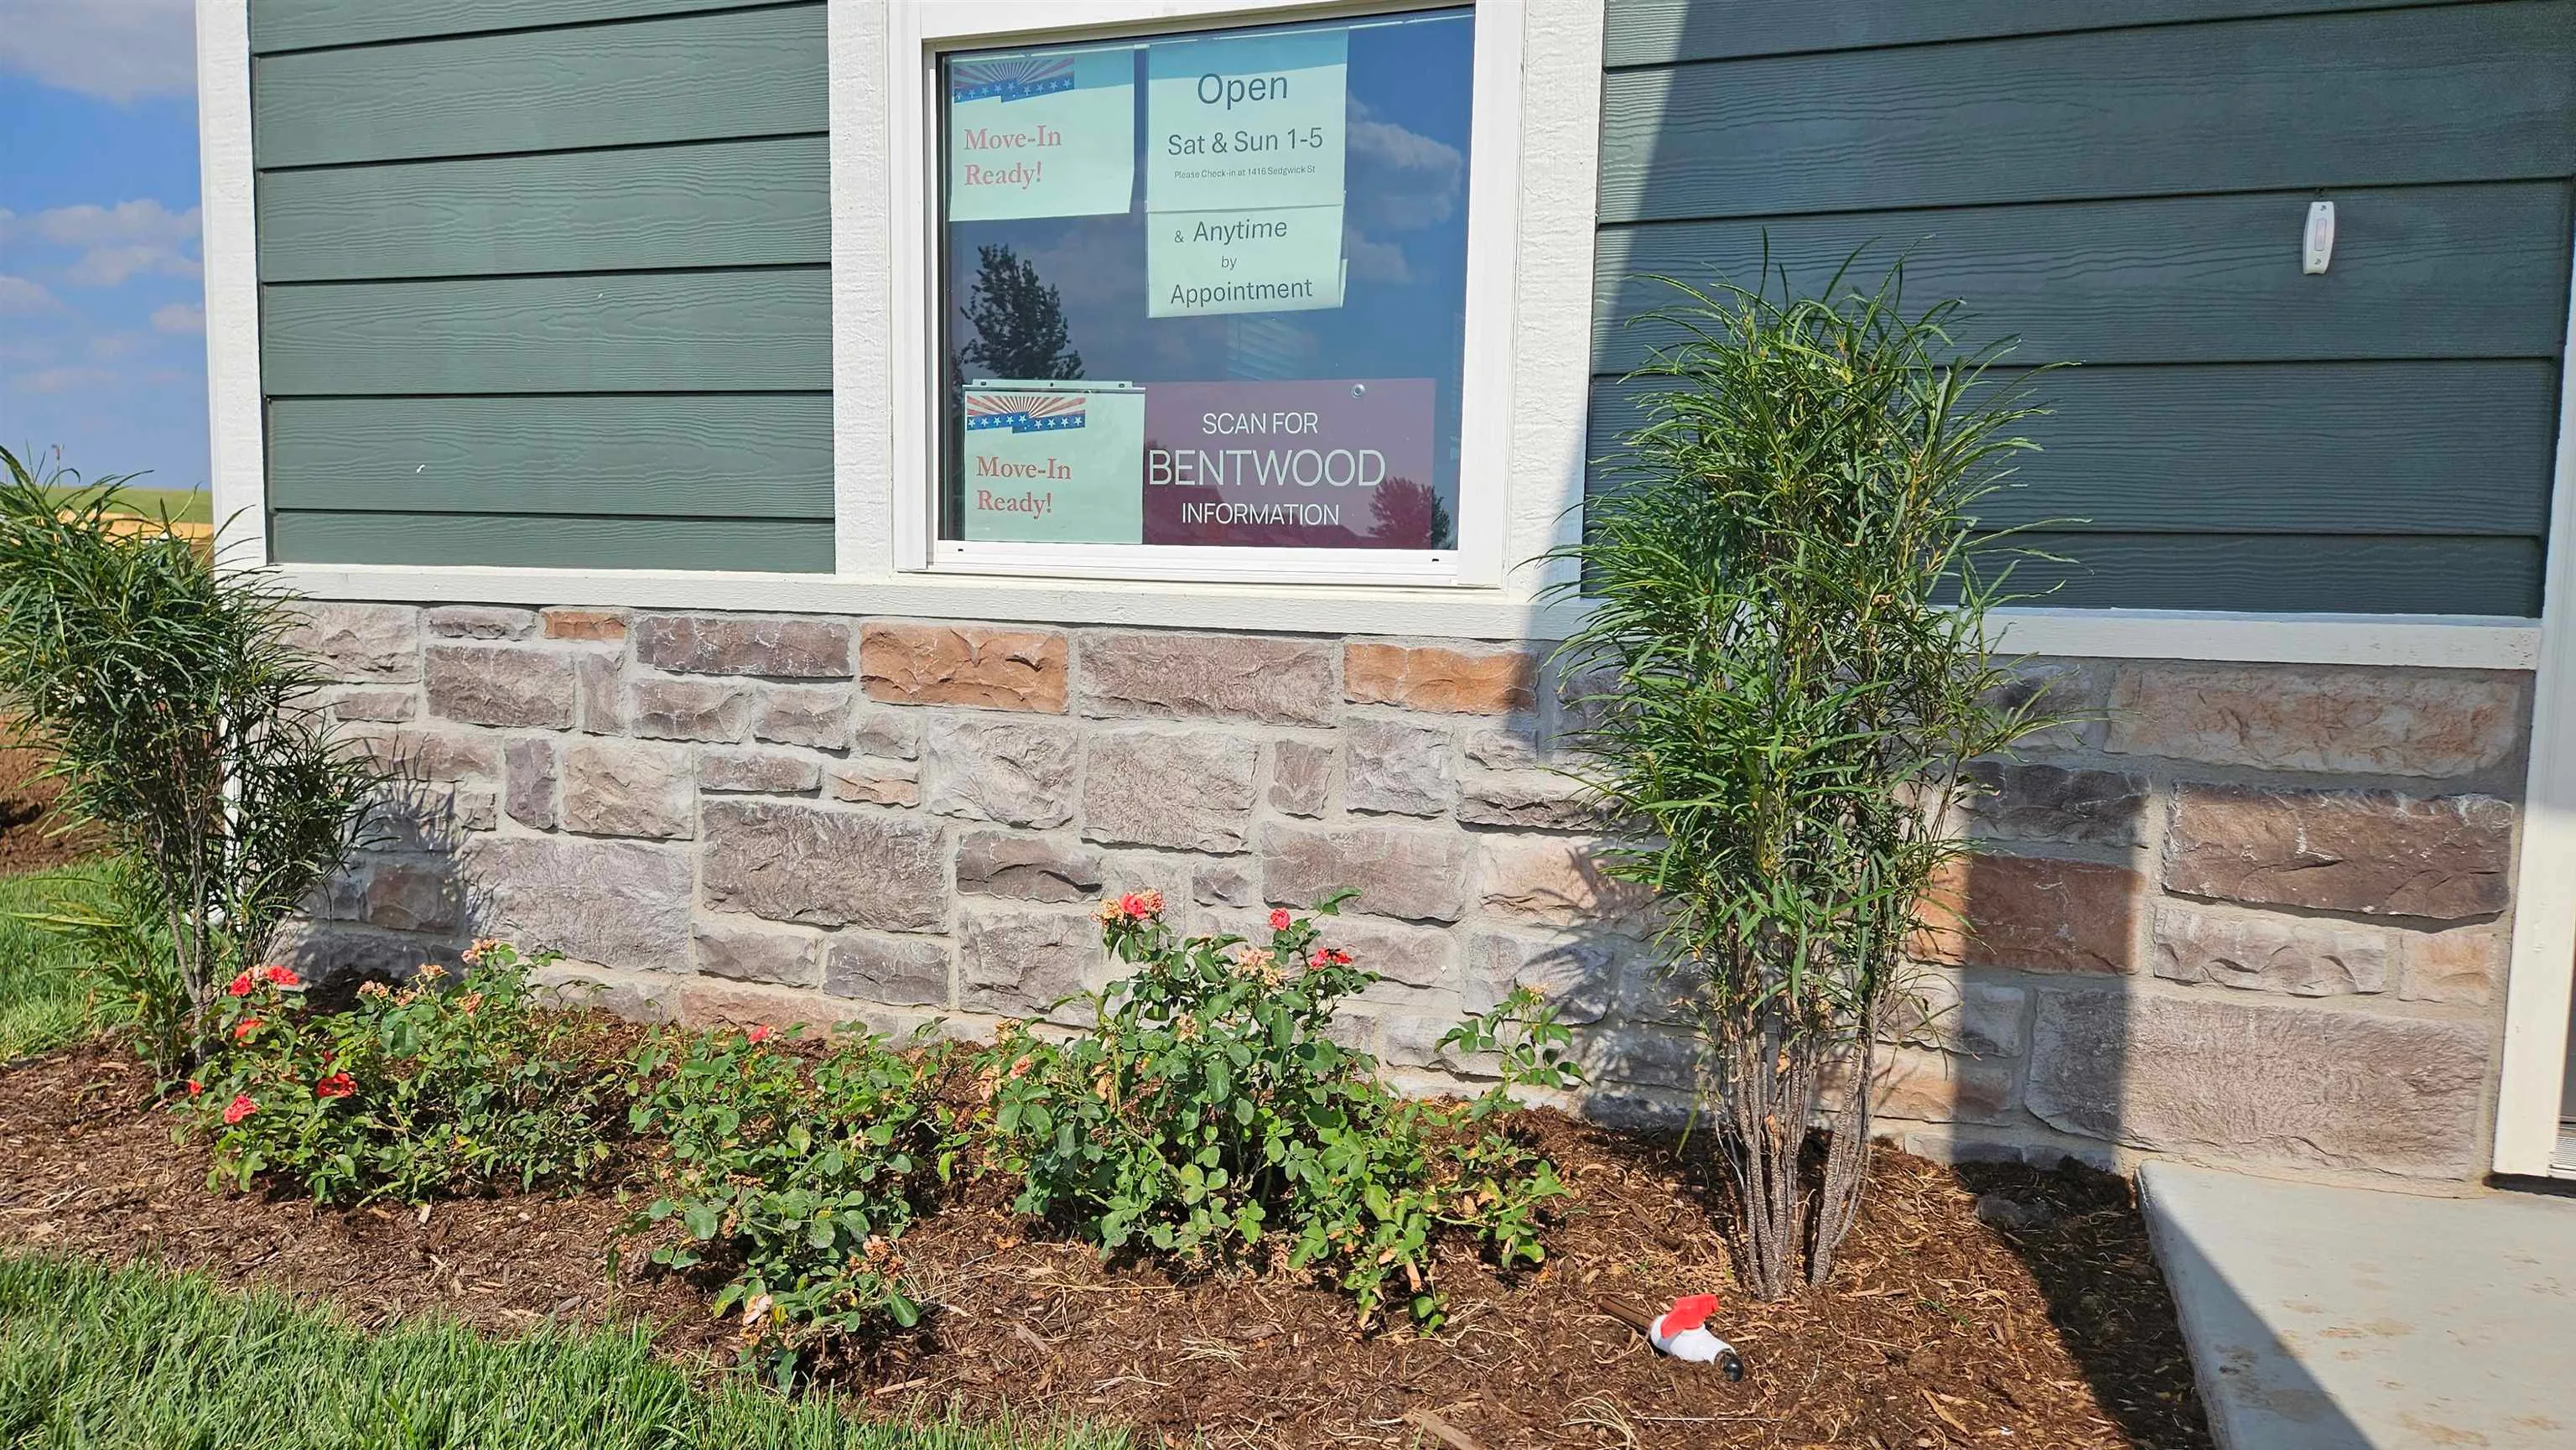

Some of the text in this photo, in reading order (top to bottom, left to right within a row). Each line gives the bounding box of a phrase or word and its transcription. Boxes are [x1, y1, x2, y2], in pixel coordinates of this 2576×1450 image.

[1197, 72, 1289, 110] Open
[963, 123, 1062, 150] Move-In
[1168, 127, 1323, 155] Sat & Sun 1-5
[963, 160, 1042, 190] Ready!
[1174, 170, 1200, 179] Please
[1201, 169, 1236, 178] Check-in
[1248, 167, 1266, 175] 1416
[1267, 165, 1306, 176] Sedgwick
[1306, 164, 1316, 173] St
[1174, 220, 1287, 245] & Anytime
[1221, 254, 1238, 271] by
[1170, 278, 1313, 307] Appointment
[1202, 412, 1318, 434] SCAN FOR
[976, 455, 1072, 481] Move-In
[1149, 449, 1386, 487] BENTWOOD
[976, 489, 1052, 520] Ready!
[1182, 502, 1340, 526] INFORMATION
